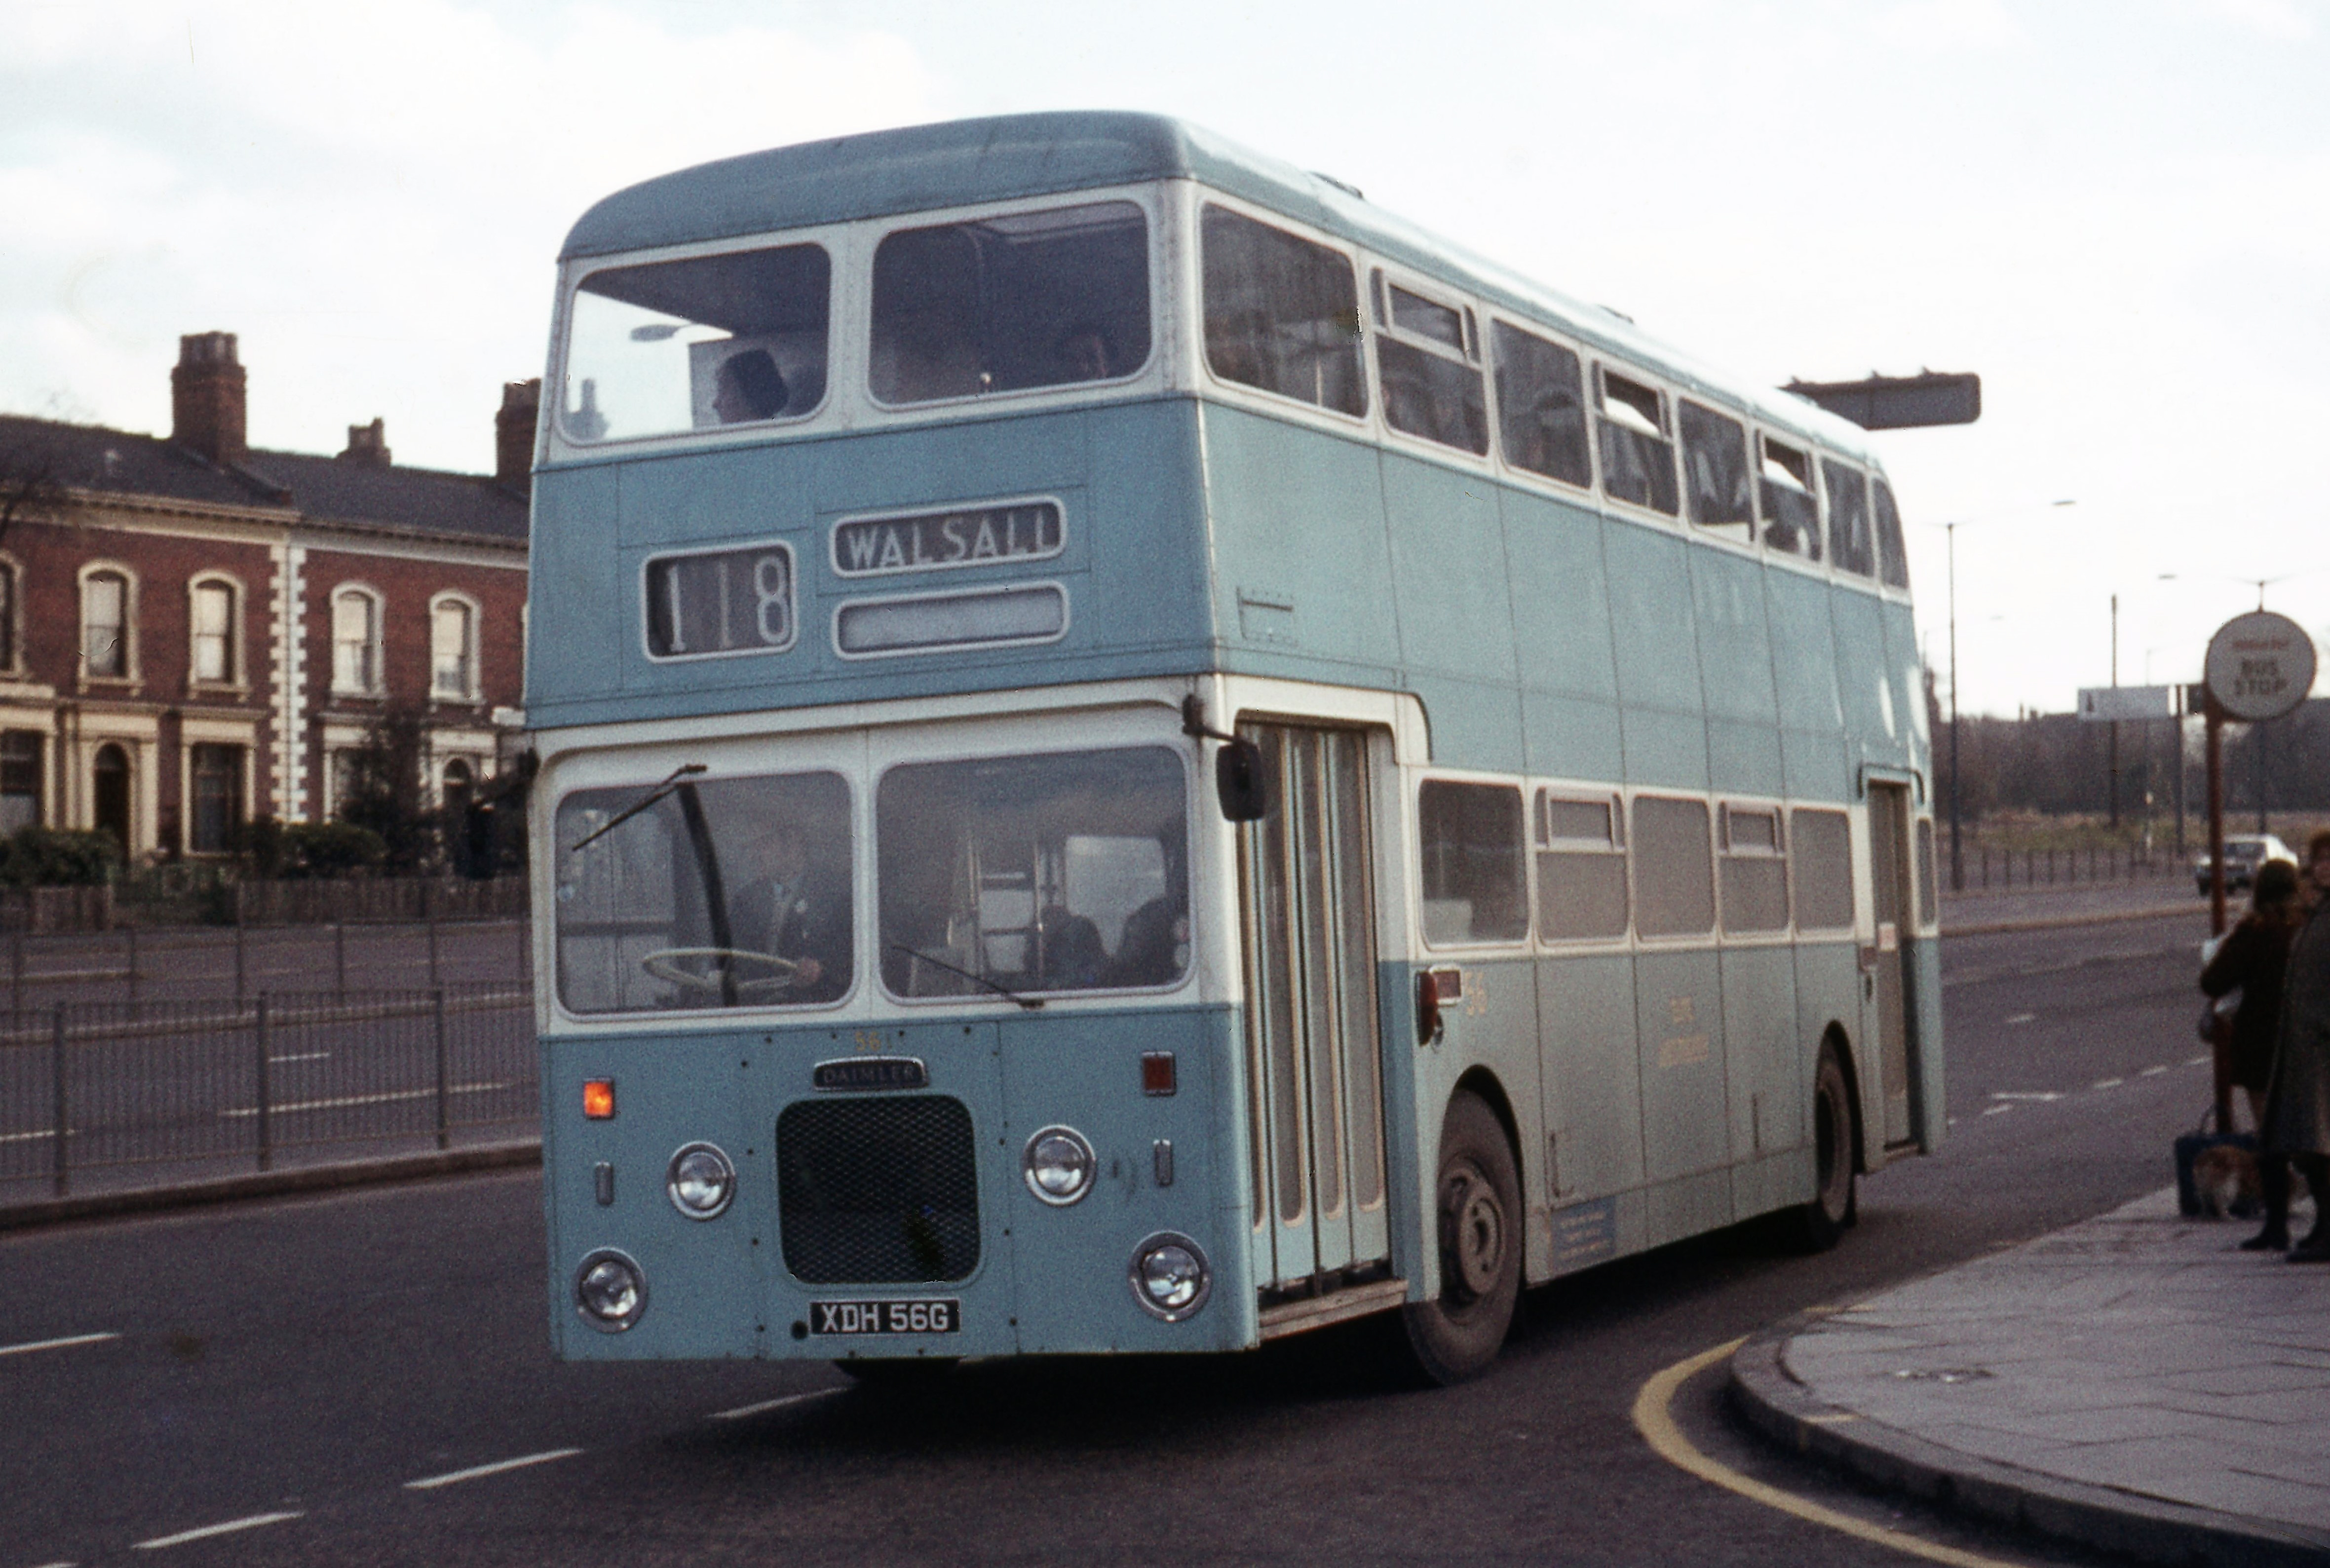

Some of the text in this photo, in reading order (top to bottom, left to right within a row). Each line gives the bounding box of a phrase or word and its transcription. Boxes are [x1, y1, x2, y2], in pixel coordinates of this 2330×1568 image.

[845, 510, 1055, 570] WALSALL
[667, 555, 790, 652] 118
[823, 1065, 915, 1083] DAIMLER
[821, 1303, 949, 1332] XDH 56G
